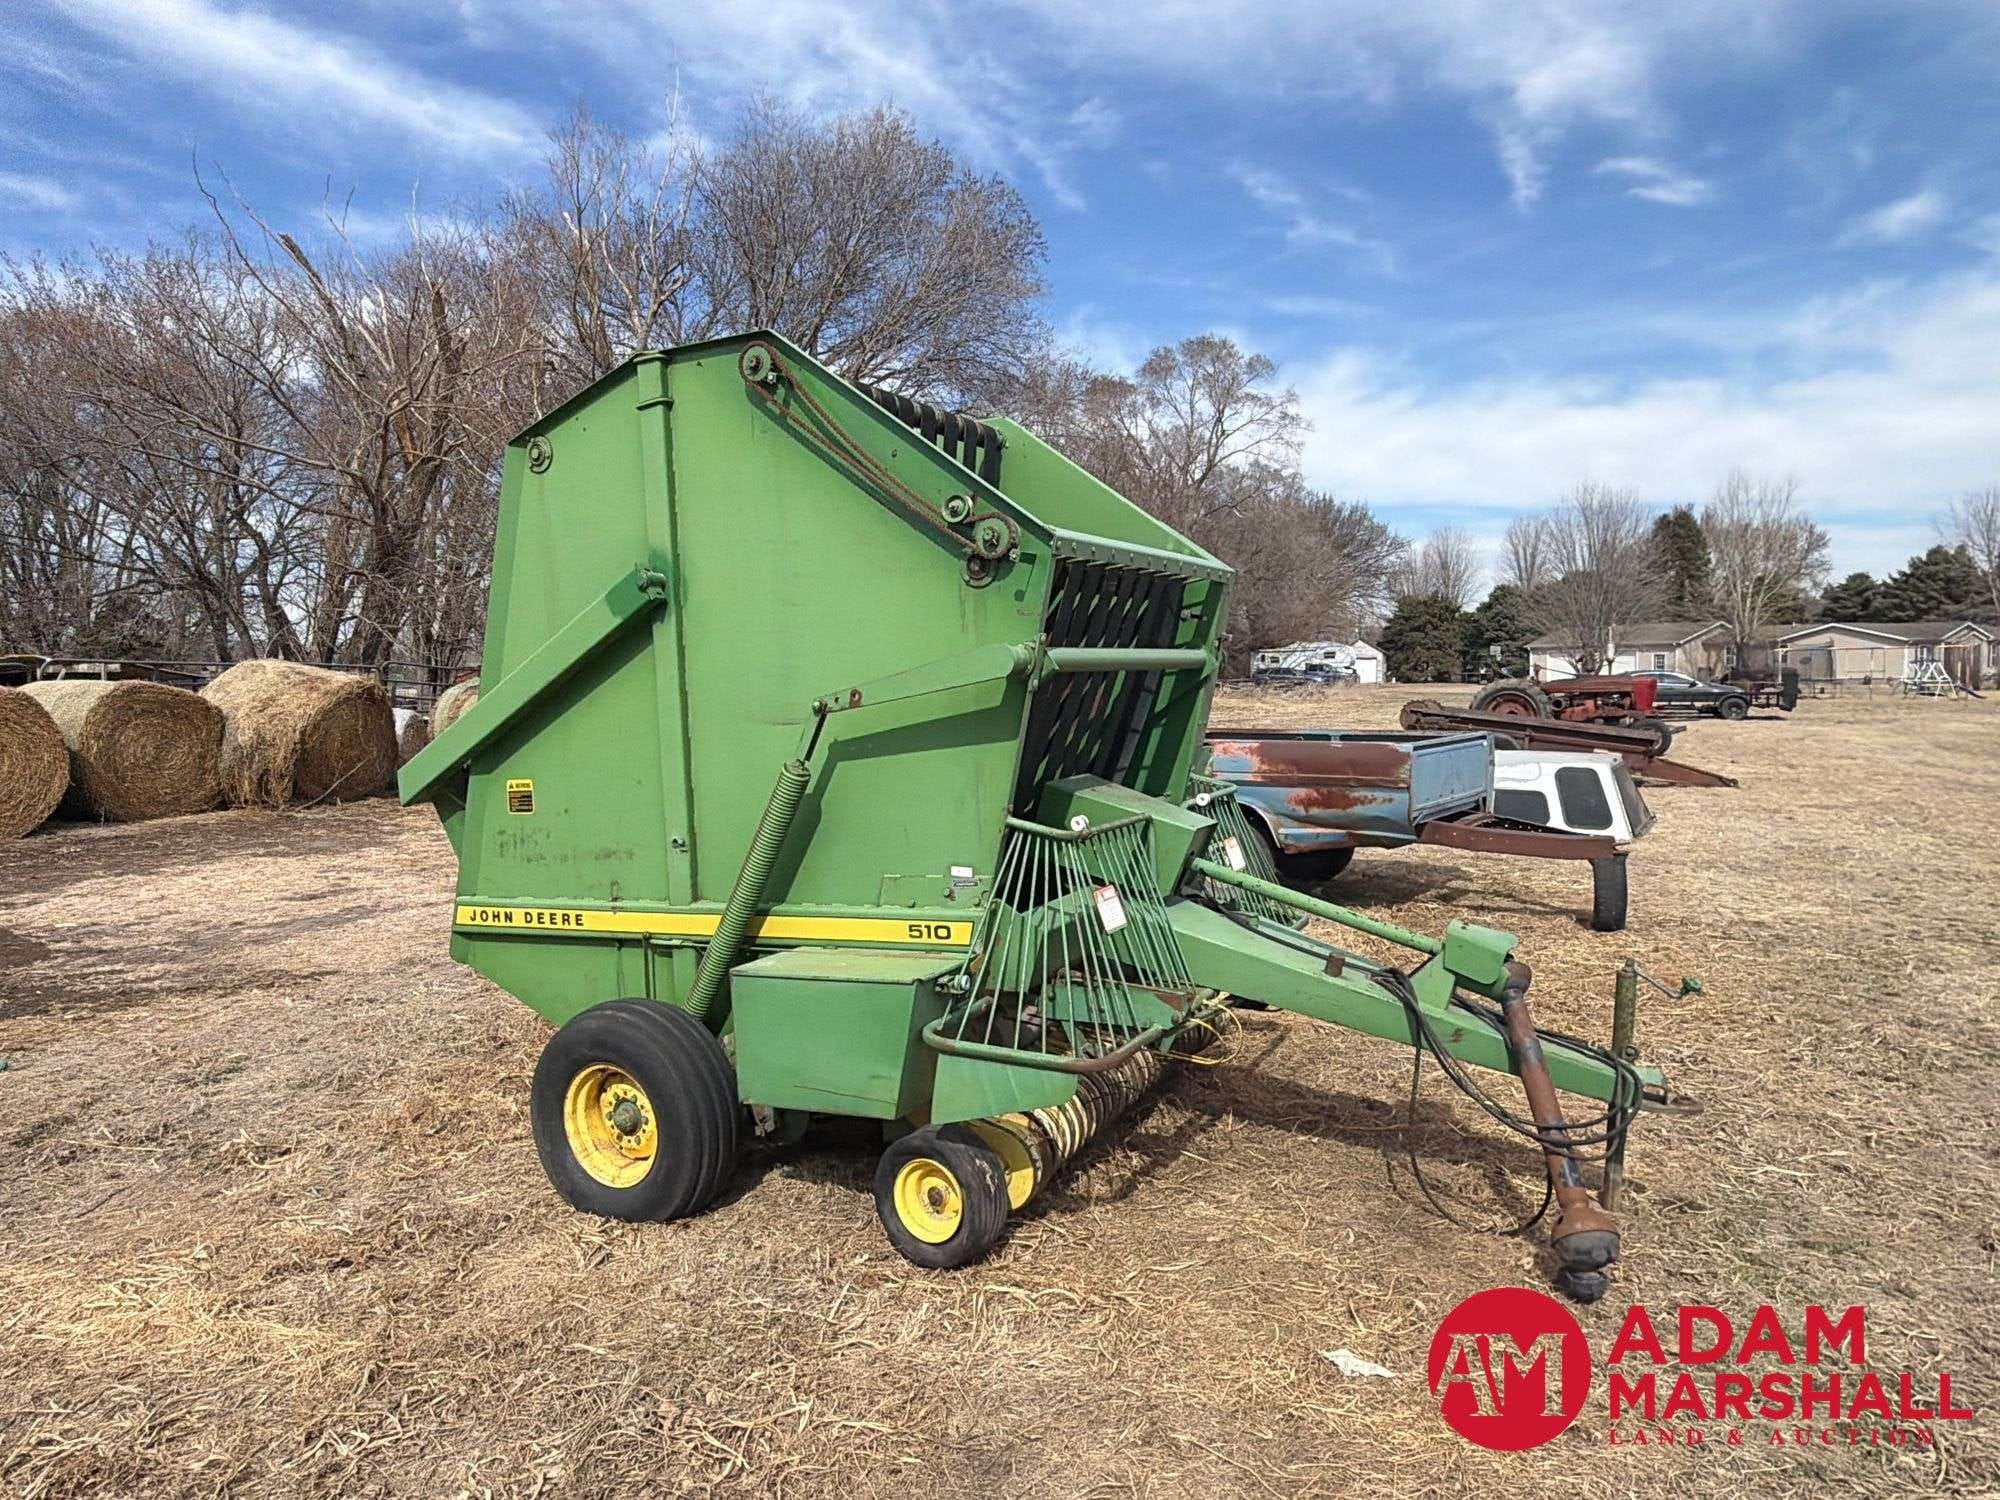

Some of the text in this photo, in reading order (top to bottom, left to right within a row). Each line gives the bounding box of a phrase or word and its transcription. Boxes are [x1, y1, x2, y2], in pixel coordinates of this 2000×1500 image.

[470, 909, 584, 926] JOHN DEERE
[908, 924, 951, 940] 510
